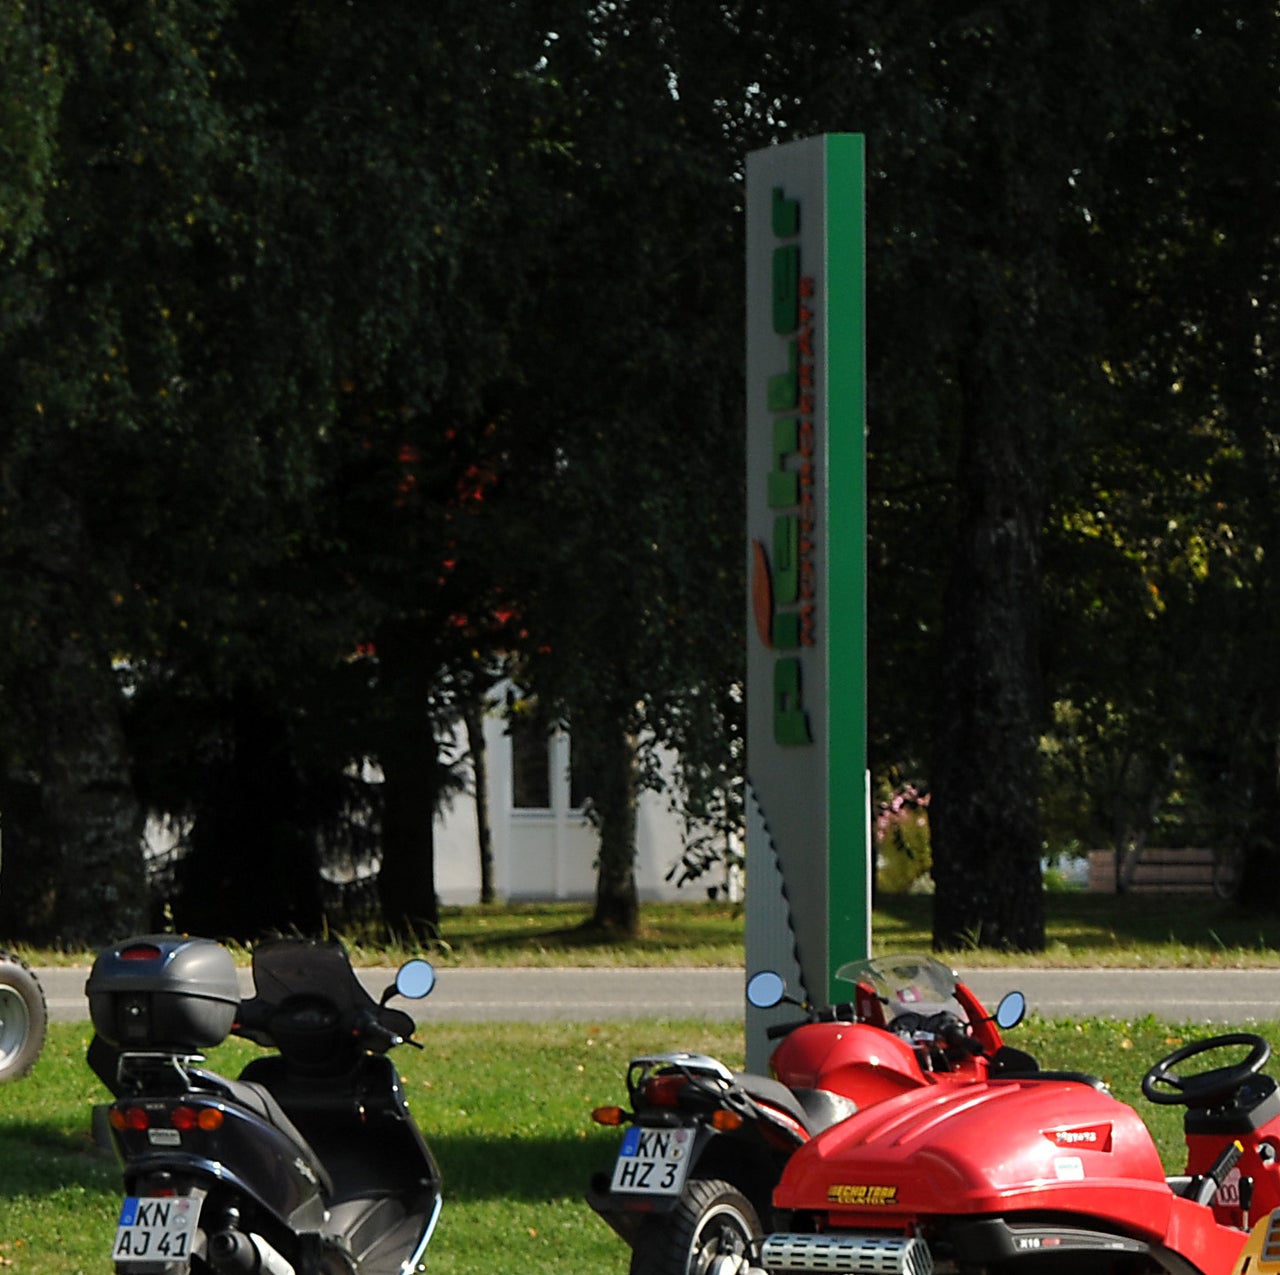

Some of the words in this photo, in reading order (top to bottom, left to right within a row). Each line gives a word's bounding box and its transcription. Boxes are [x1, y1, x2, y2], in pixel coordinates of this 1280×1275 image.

[636, 1132, 670, 1158] KN
[620, 1162, 655, 1188] HZ
[660, 1163, 678, 1188] 3
[135, 1203, 171, 1227] KN
[117, 1231, 151, 1257] AJ
[157, 1231, 187, 1257] 41
